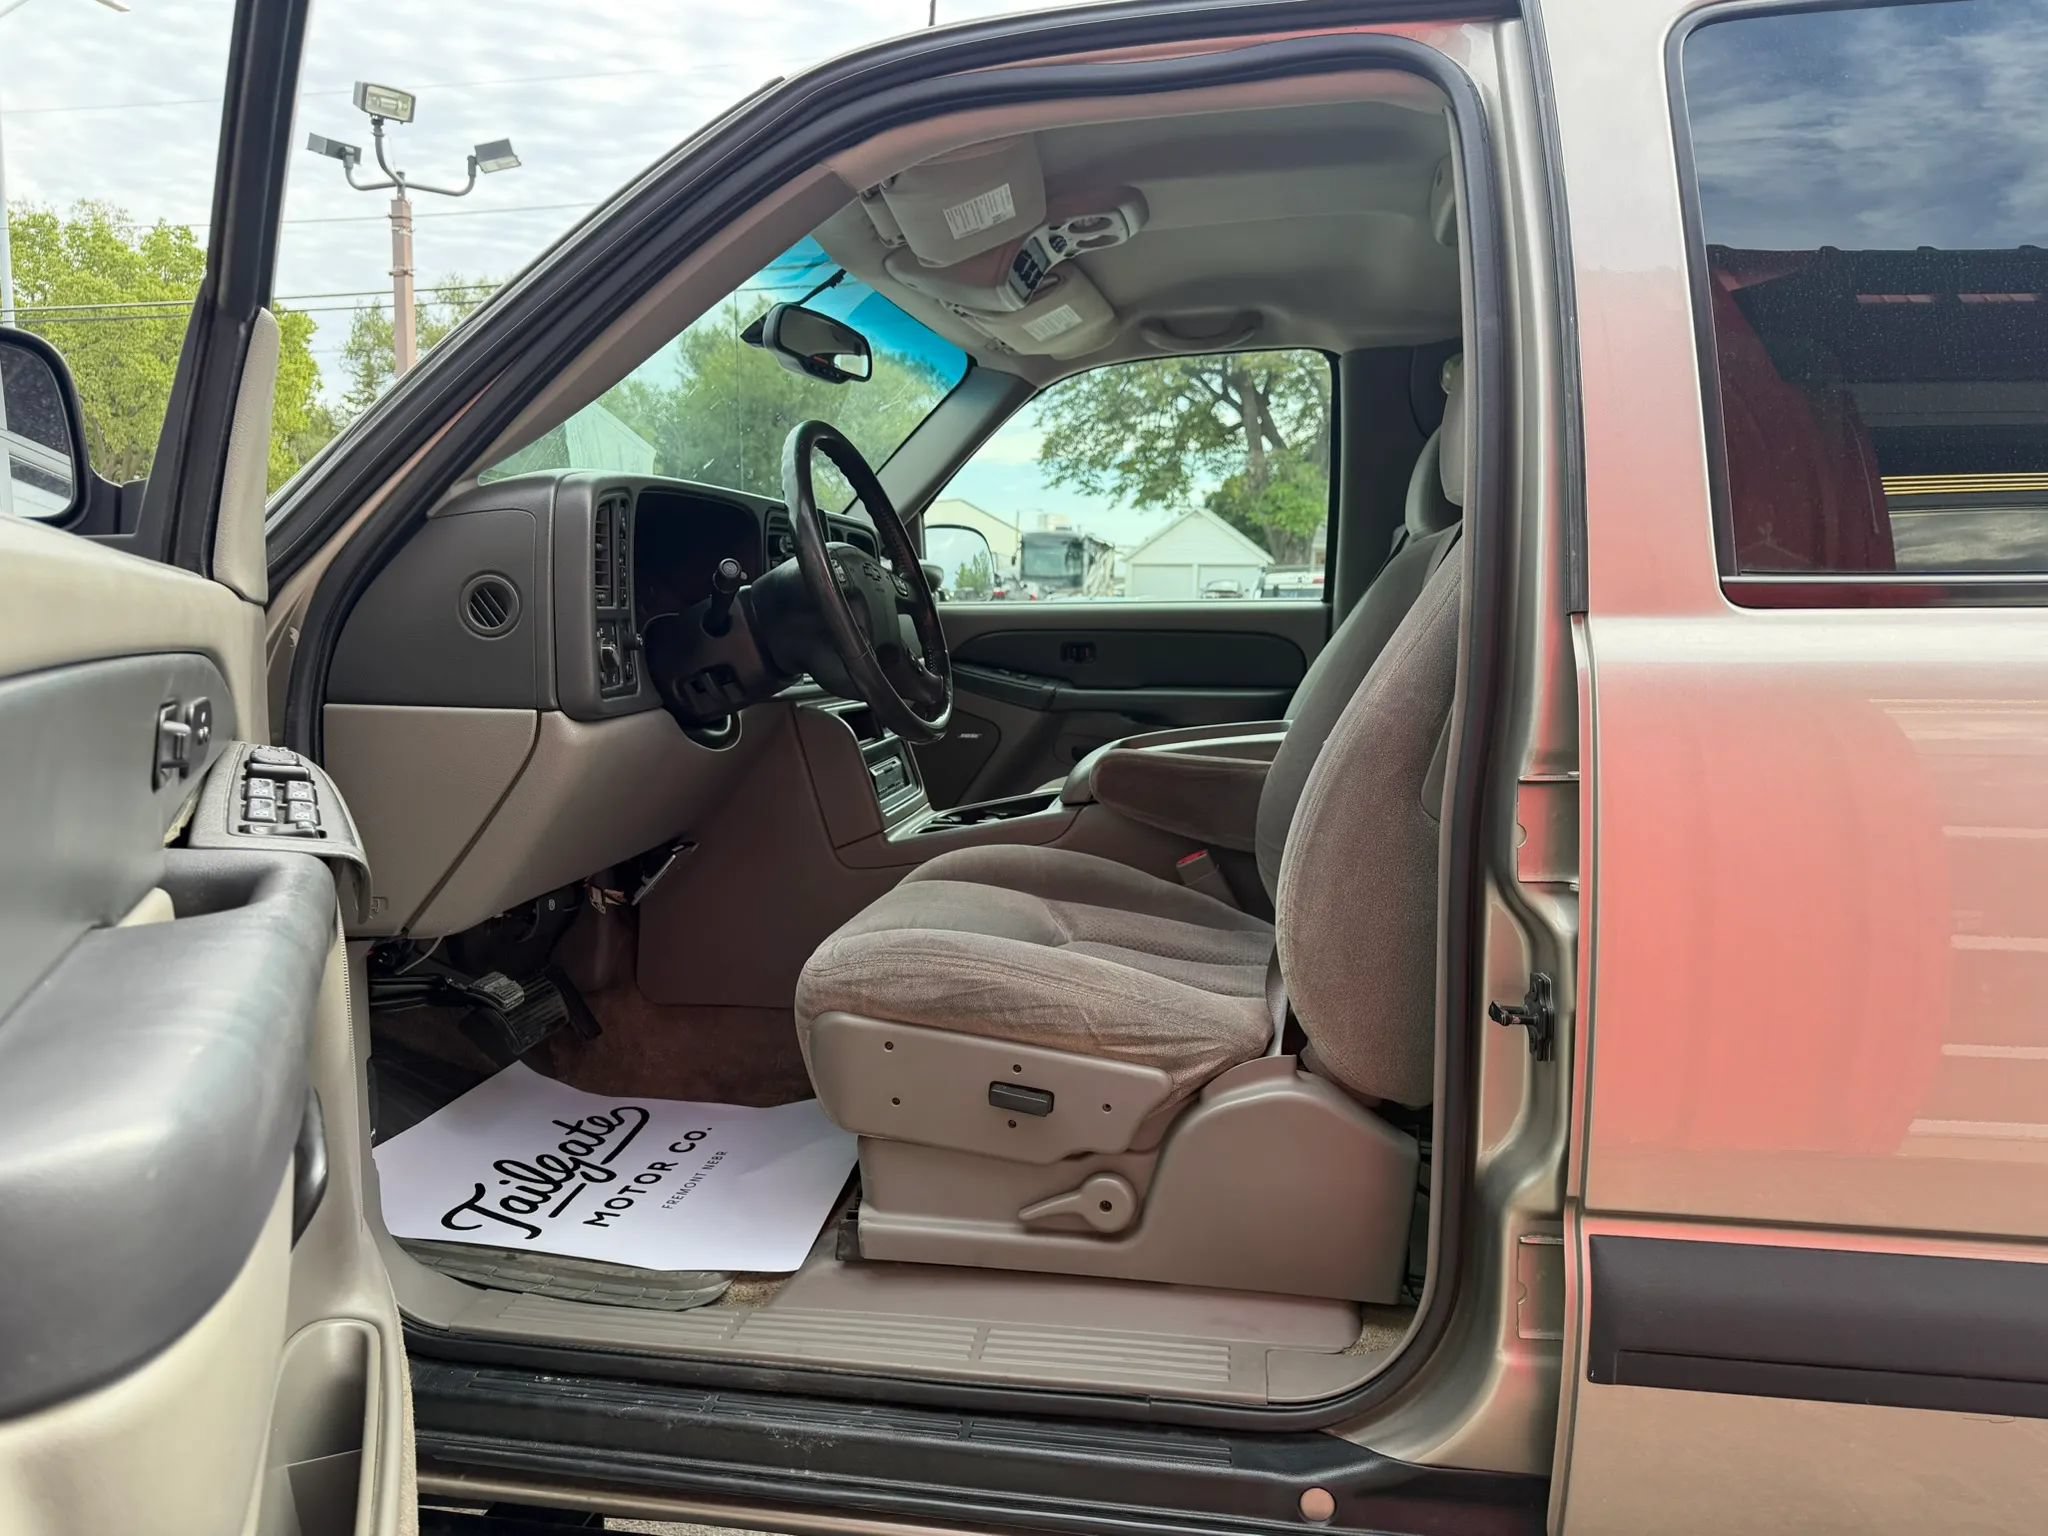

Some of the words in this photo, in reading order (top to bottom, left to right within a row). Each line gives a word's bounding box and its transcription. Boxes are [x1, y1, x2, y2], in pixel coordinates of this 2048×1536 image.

[441, 1106, 650, 1239] Tailgate
[582, 1161, 679, 1227] MOTOR
[669, 1127, 712, 1153] CO.
[662, 1172, 707, 1209] FREMONT
[702, 1151, 728, 1170] NEBR
